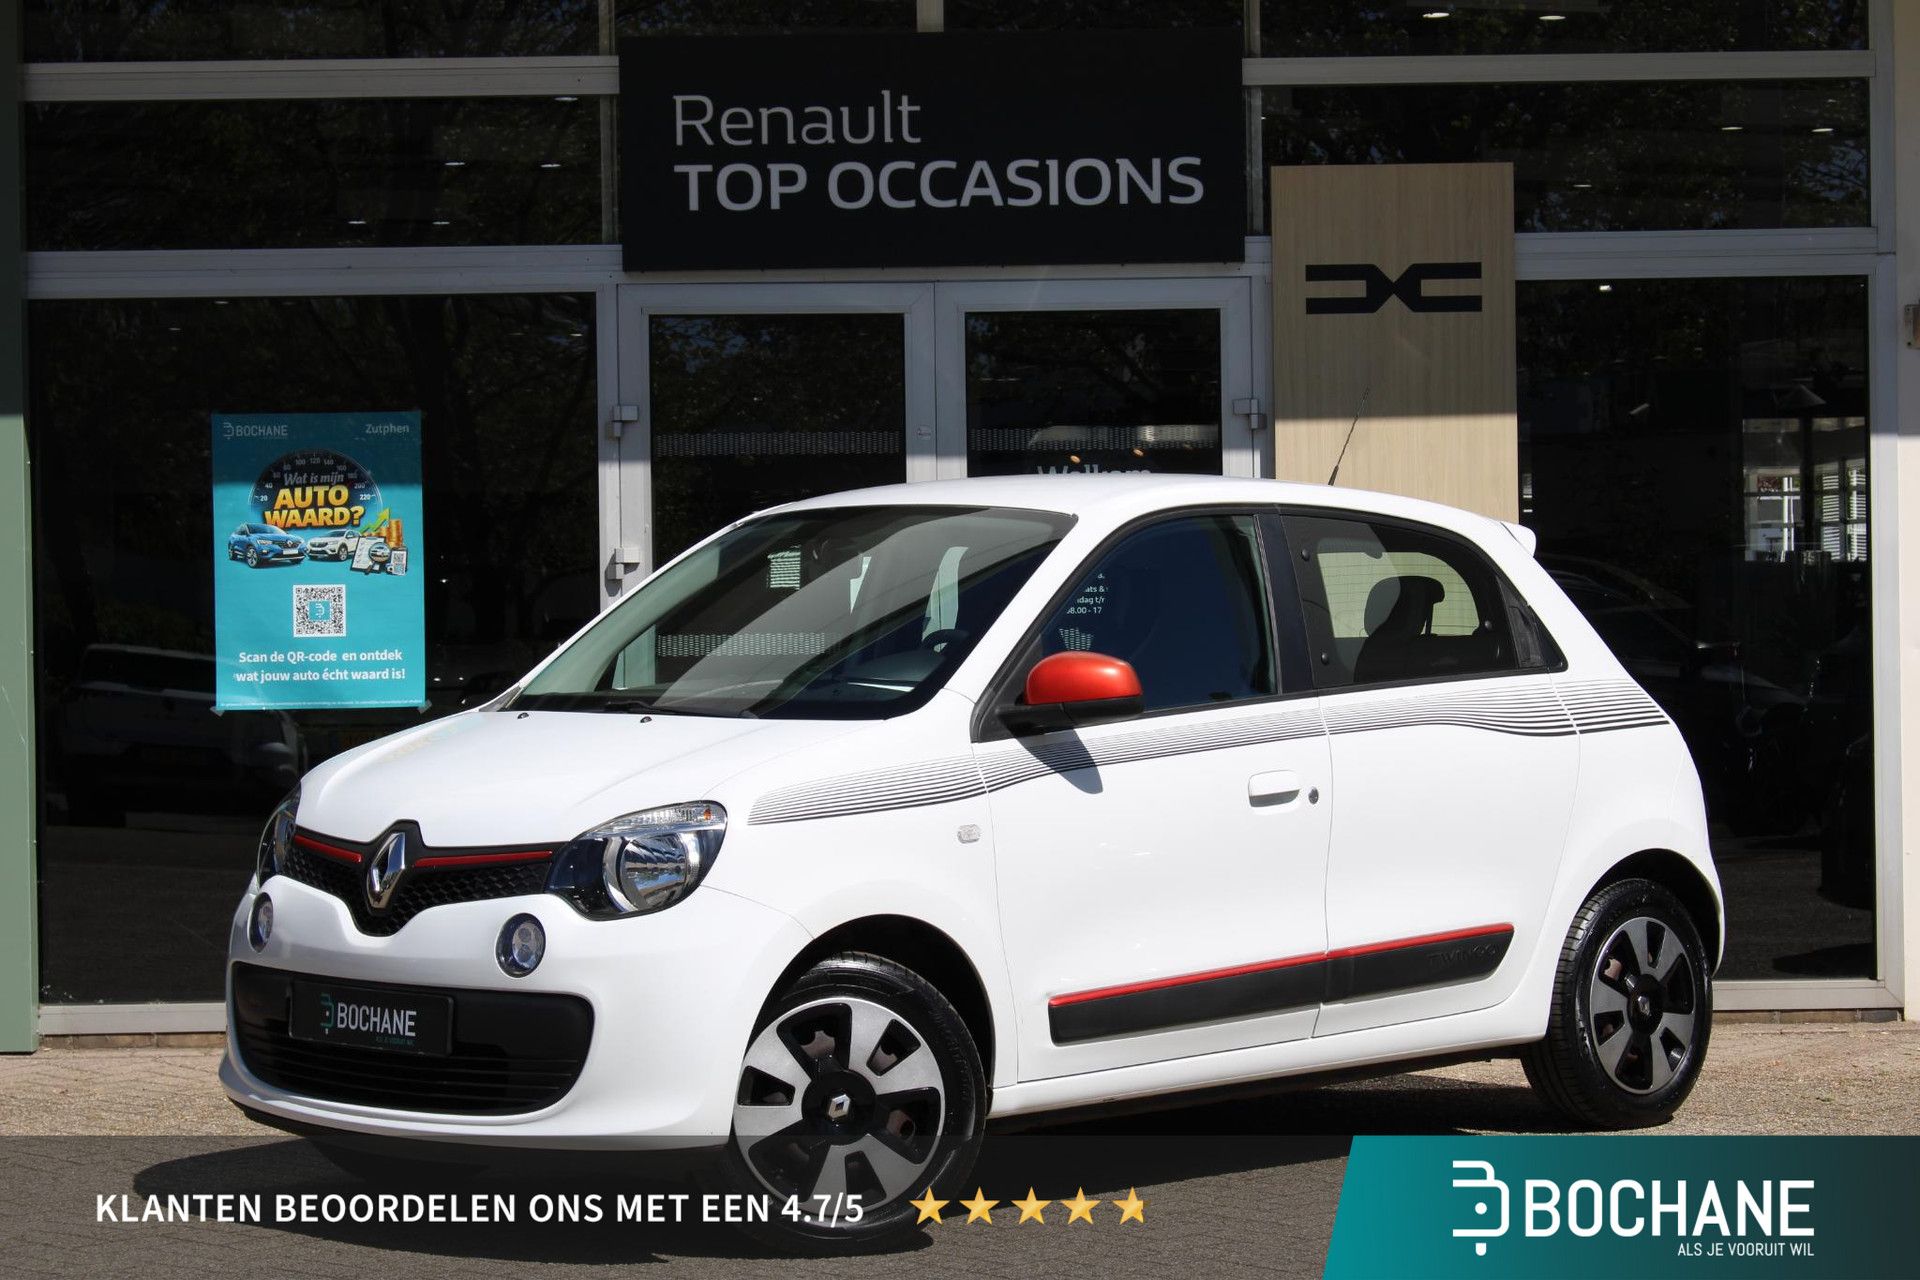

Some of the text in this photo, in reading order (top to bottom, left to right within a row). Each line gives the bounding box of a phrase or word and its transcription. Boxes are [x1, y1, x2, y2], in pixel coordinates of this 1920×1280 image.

[673, 89, 921, 146] Renault
[673, 156, 1204, 212] TOP OCCASIONS
[236, 425, 288, 436] BOCHANE
[365, 423, 410, 435] Zutphen
[283, 472, 344, 486] Wat is mijn
[273, 485, 349, 509] AUTO
[264, 505, 365, 528] WAARD?
[239, 649, 403, 665] Scan de QR-code en ontdek
[236, 668, 406, 684] wat jouw auto écht waard is!
[336, 1001, 417, 1037] BOCHANE
